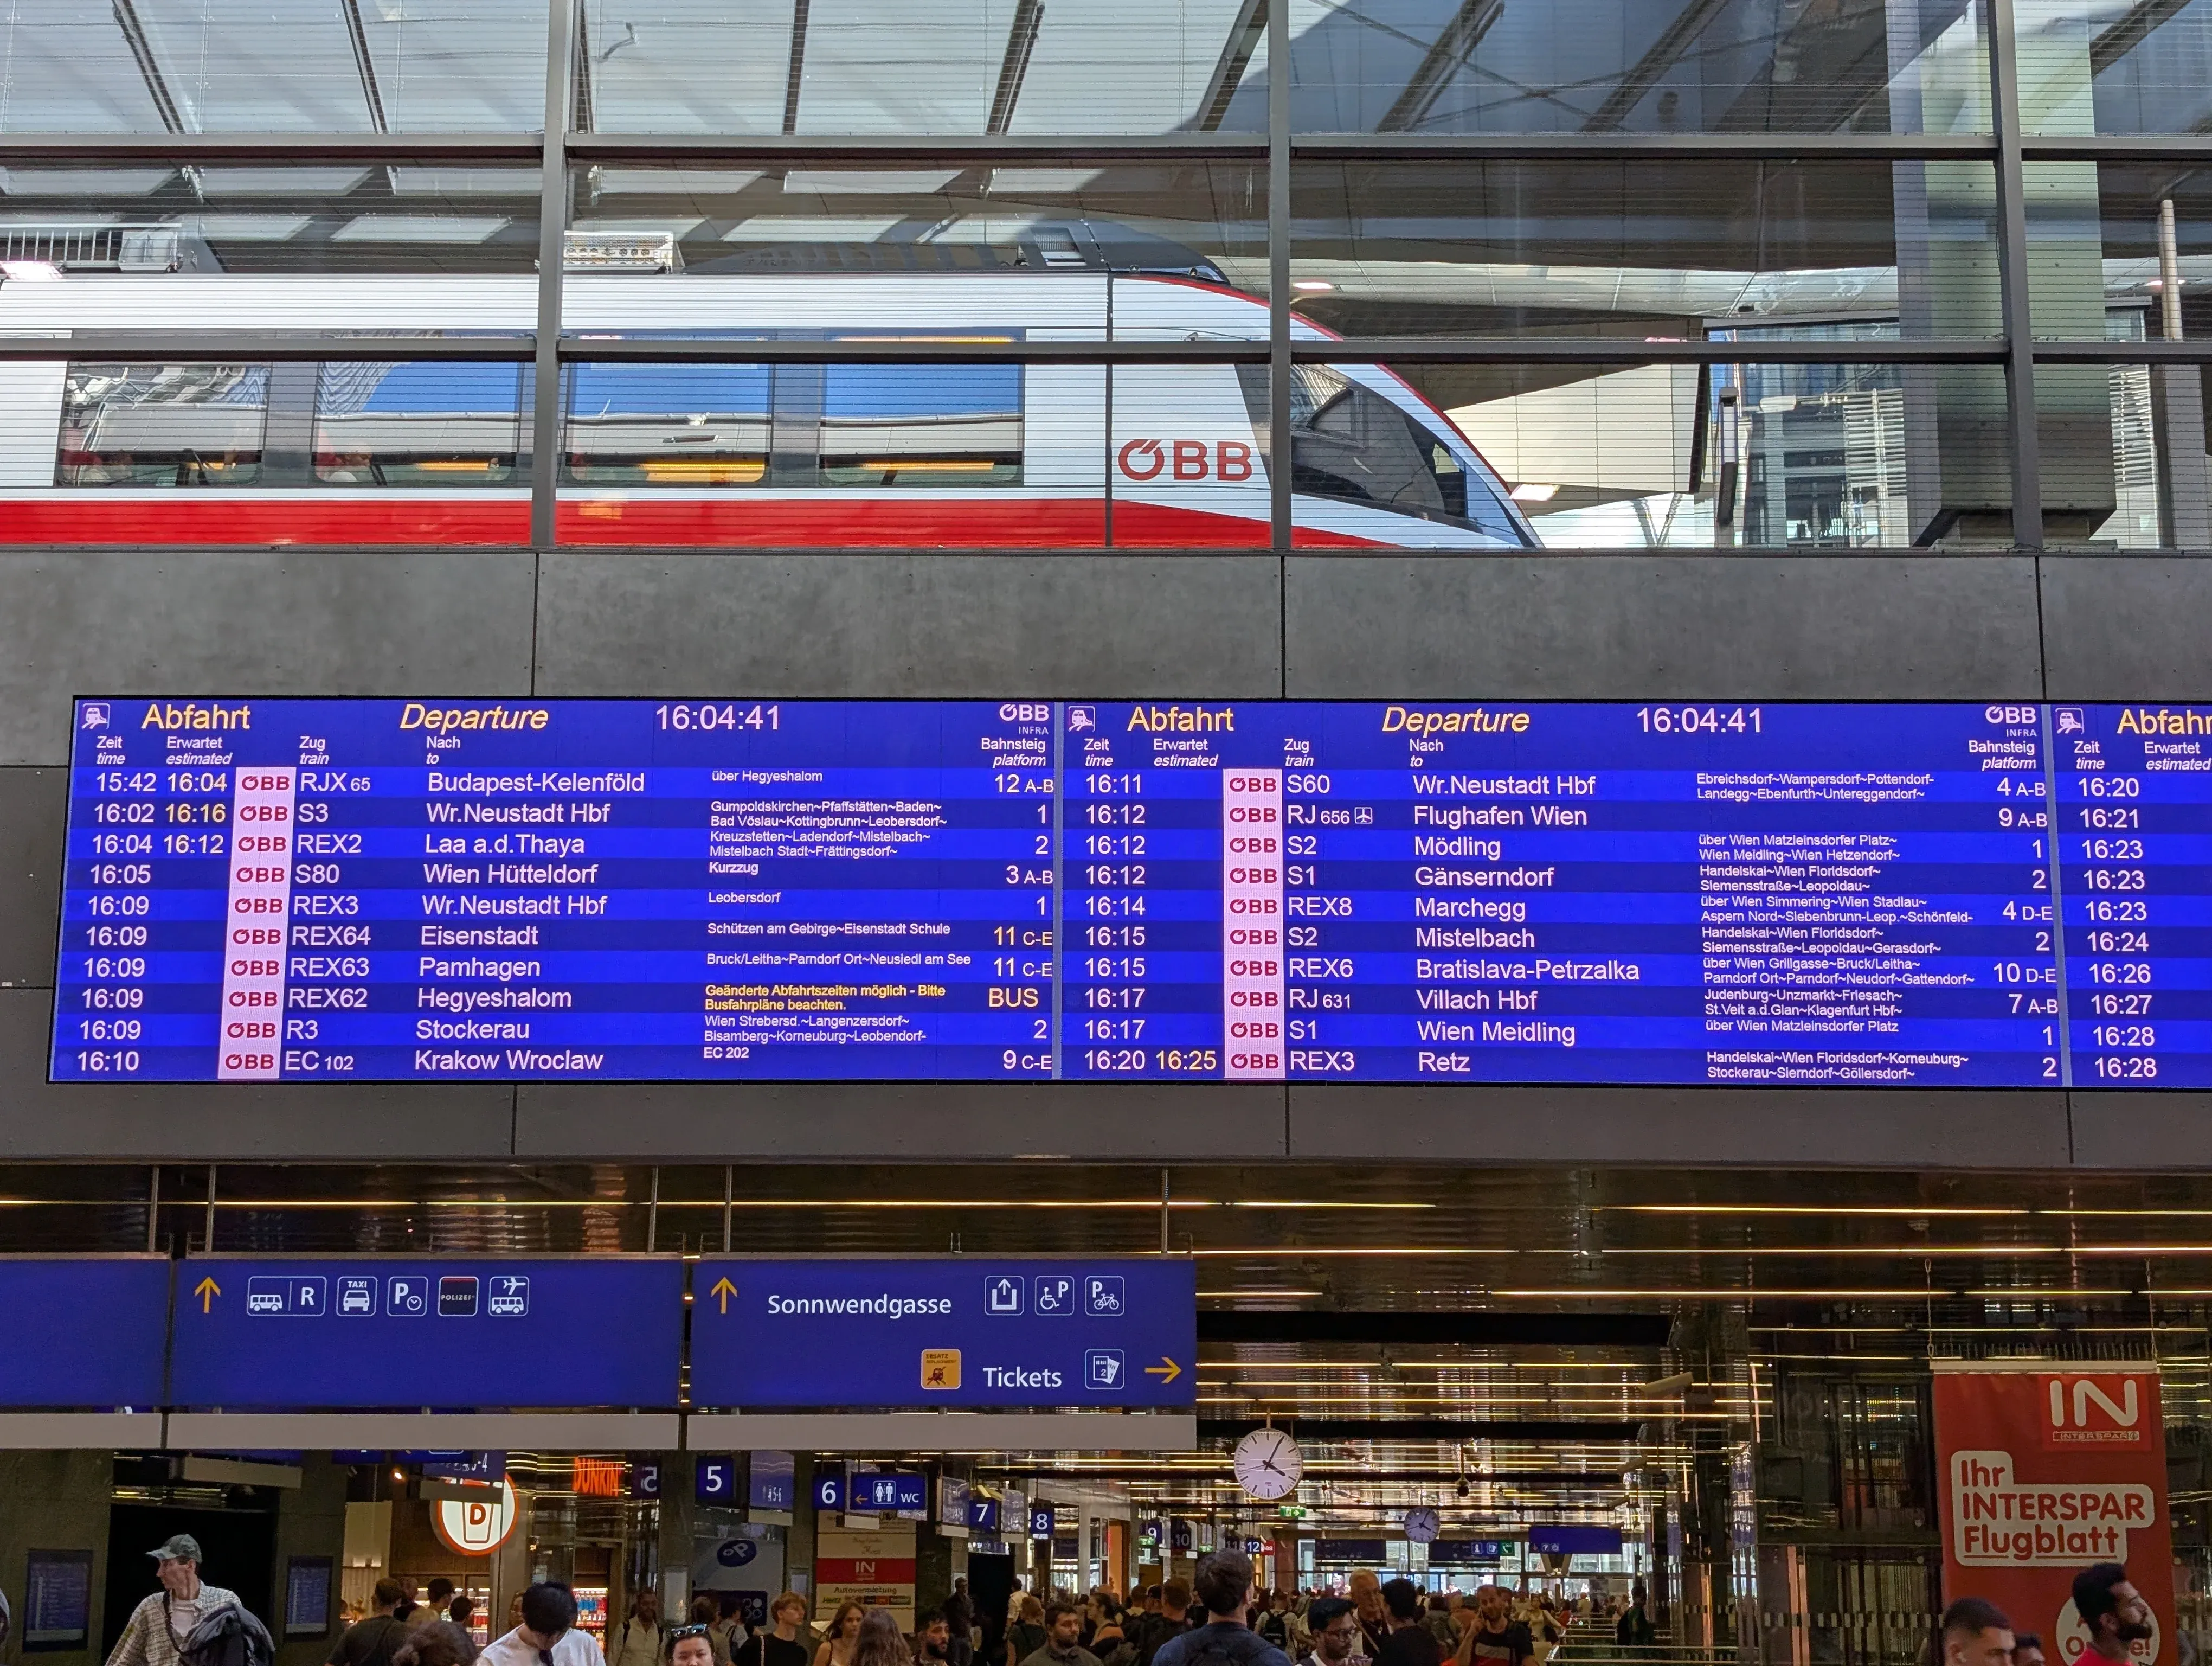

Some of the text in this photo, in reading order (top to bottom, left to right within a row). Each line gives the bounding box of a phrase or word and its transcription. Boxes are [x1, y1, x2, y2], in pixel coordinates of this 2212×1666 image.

[1118, 439, 1252, 481] ÖBB
[140, 704, 251, 729] Abfahrt
[399, 703, 549, 735] Departure
[656, 704, 778, 730] 16:04:41
[999, 703, 1049, 721] ÖBB
[1127, 706, 1234, 731] Abfahrt
[1637, 707, 1760, 733] 16:04:41
[1985, 706, 2036, 724] ÖBB
[1018, 726, 1049, 735] INFRA
[1382, 707, 1530, 738] Departure
[96, 735, 123, 749] Zeit
[166, 736, 223, 749] Erwartet
[426, 735, 461, 748] Nach
[2006, 729, 2037, 738] INFRA
[299, 736, 326, 752] Zug
[981, 737, 1046, 753] Bahnsteig
[1969, 740, 2035, 756] Bahnsteig
[2074, 740, 2100, 753] Zeit
[2144, 741, 2201, 754] Erwartet
[97, 752, 126, 765] time
[166, 752, 233, 765] estimated
[299, 752, 330, 765] train
[426, 752, 440, 765] to
[992, 753, 1046, 769] platform
[2076, 757, 2105, 770] time
[2146, 757, 2212, 770] estimated
[97, 772, 228, 792] 15:42 16:04
[241, 776, 290, 791] ÖBB
[300, 772, 370, 792] RJX 65
[428, 772, 645, 797] Budapest-Kelenföld
[712, 770, 823, 784] über Hegyeshalom
[995, 773, 1054, 793] 12 A-B
[2078, 777, 2139, 797] 16:20
[1086, 804, 1146, 824] 16:12
[1229, 807, 1277, 823] ÖBB
[1288, 805, 1350, 824] RJ 656
[1414, 805, 1587, 830] Flughafen Wien
[1998, 808, 2047, 828] 9 A-B
[2080, 808, 2138, 828] 16:21
[93, 834, 224, 854] 16:04 16:12
[238, 836, 286, 852] ÖBB
[297, 834, 362, 854] REX2
[426, 834, 584, 858] Laa a.d.Thaya
[710, 845, 774, 857] Mistelbach
[1035, 835, 1049, 854] 2
[2082, 839, 2143, 859] 16:23
[2084, 869, 2145, 889] 16:23
[1085, 896, 1146, 917] 16:14
[1230, 899, 1277, 914] ÖBB
[1288, 896, 1352, 916] REX8
[1416, 897, 1526, 922] Marchegg
[1701, 895, 1729, 907] über
[1731, 895, 1763, 907] Wien
[2002, 900, 2052, 920] 4 D-E
[2085, 901, 2147, 921] 16:23
[1701, 910, 1745, 924] Aspern
[86, 926, 147, 946] 16:09
[233, 928, 281, 945] ÖBB
[292, 926, 371, 946] REX64
[421, 925, 539, 945] Eisenstadt
[708, 922, 763, 934] Schützen
[767, 925, 786, 934] am
[909, 922, 950, 934] Schule
[994, 926, 1053, 945] 11 C-E
[2087, 931, 2149, 952] 16:24
[2089, 963, 2151, 983] 16:26
[82, 988, 143, 1008] 16:09
[229, 991, 278, 1007] ÖBB
[288, 988, 368, 1008] REX62
[418, 987, 571, 1013] Hegyeshalom
[705, 984, 769, 996] Geänderte
[770, 984, 857, 996] Abfahrtszeiten
[860, 984, 907, 999] möglich
[918, 984, 946, 997] Bitte
[989, 988, 1038, 1007] BUS
[1084, 988, 1146, 1008] 16:17
[1230, 991, 1278, 1007] ÖBB
[1289, 988, 1350, 1009] RJ 631
[1416, 989, 1538, 1010] Villach Hbf
[705, 998, 846, 1013] Busfahrpläne beachten.
[1705, 1003, 1746, 1015] St.Veit
[2008, 994, 2056, 1014] 7 A-B
[2091, 994, 2152, 1014] 16:27
[2093, 1026, 2155, 1046] 16:28
[1085, 1050, 1217, 1070] 16:20 16:25
[1231, 1054, 1279, 1069] ÖBB
[1290, 1050, 1353, 1071] REX3
[1419, 1052, 1470, 1072] Retz
[2042, 1057, 2057, 1077] 2
[2094, 1057, 2157, 1078] 16:28
[301, 1287, 314, 1306] R
[395, 1283, 408, 1304] P
[1058, 1281, 1069, 1298] P
[1092, 1281, 1103, 1298] P
[768, 1294, 951, 1319] Sonnwendgasse
[983, 1367, 1062, 1388] Tickets
[2050, 1380, 2138, 1427] IN
[706, 1466, 722, 1491] 5
[1961, 1459, 2005, 1488] Ihr
[821, 1481, 836, 1504] 6
[901, 1493, 919, 1503] WC
[470, 1503, 486, 1525] D
[976, 1504, 988, 1522] 7
[1963, 1492, 2145, 1520] INTERSPAR
[1036, 1513, 1047, 1530] 8
[1148, 1527, 1156, 1543] 9
[1175, 1534, 1190, 1546] 10
[1964, 1524, 2119, 1560] Flugblatt
[1247, 1541, 1259, 1552] 12
[856, 1561, 876, 1573] IN
